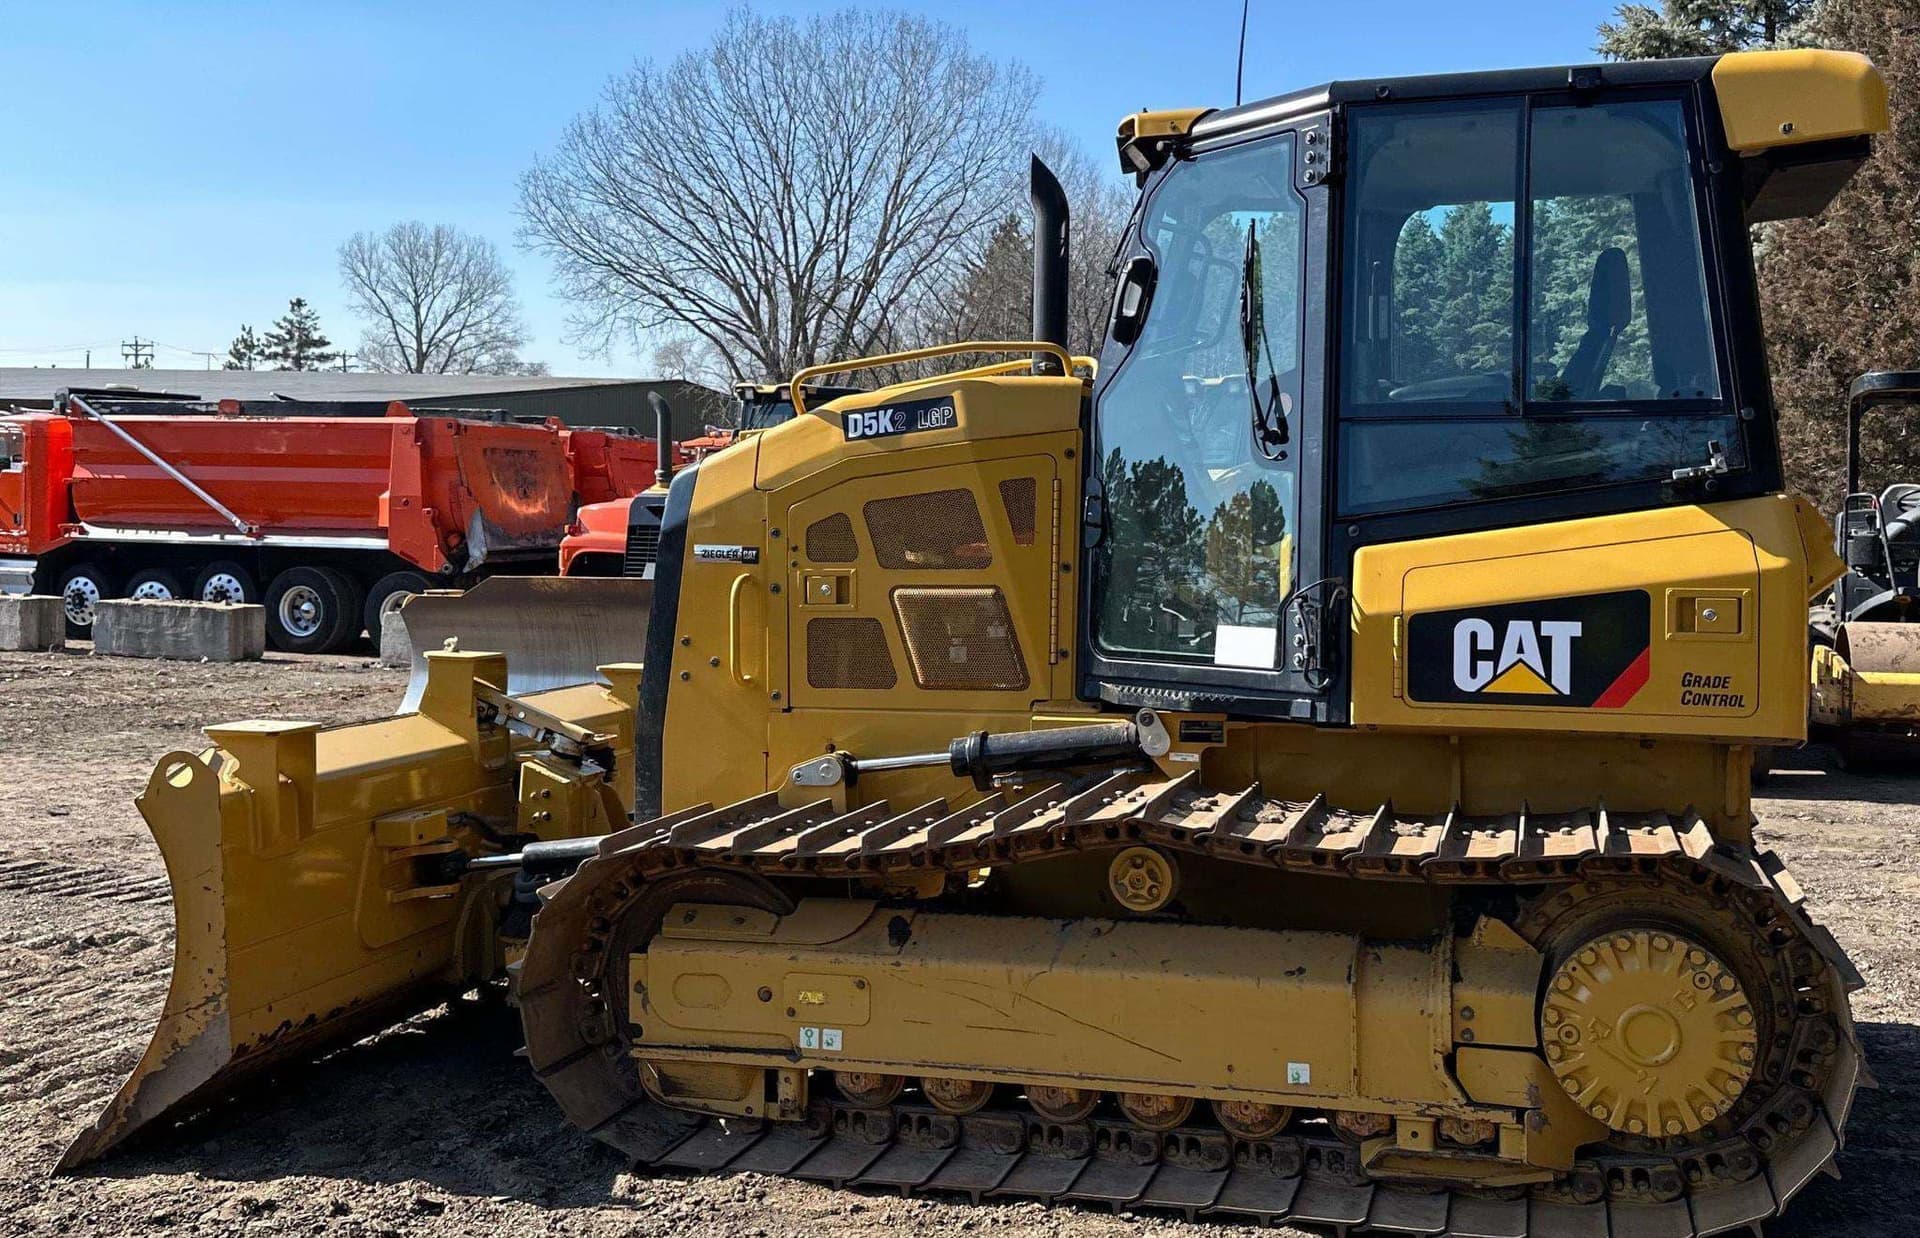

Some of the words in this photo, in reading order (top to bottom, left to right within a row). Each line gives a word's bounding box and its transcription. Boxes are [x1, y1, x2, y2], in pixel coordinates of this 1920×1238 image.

[917, 406, 954, 429] LGP
[701, 549, 739, 559] ZIEGLER
[743, 550, 757, 560] CAT
[1453, 618, 1582, 695] CAT
[1681, 672, 1732, 689] GRADE
[1681, 690, 1746, 708] CONTROL
